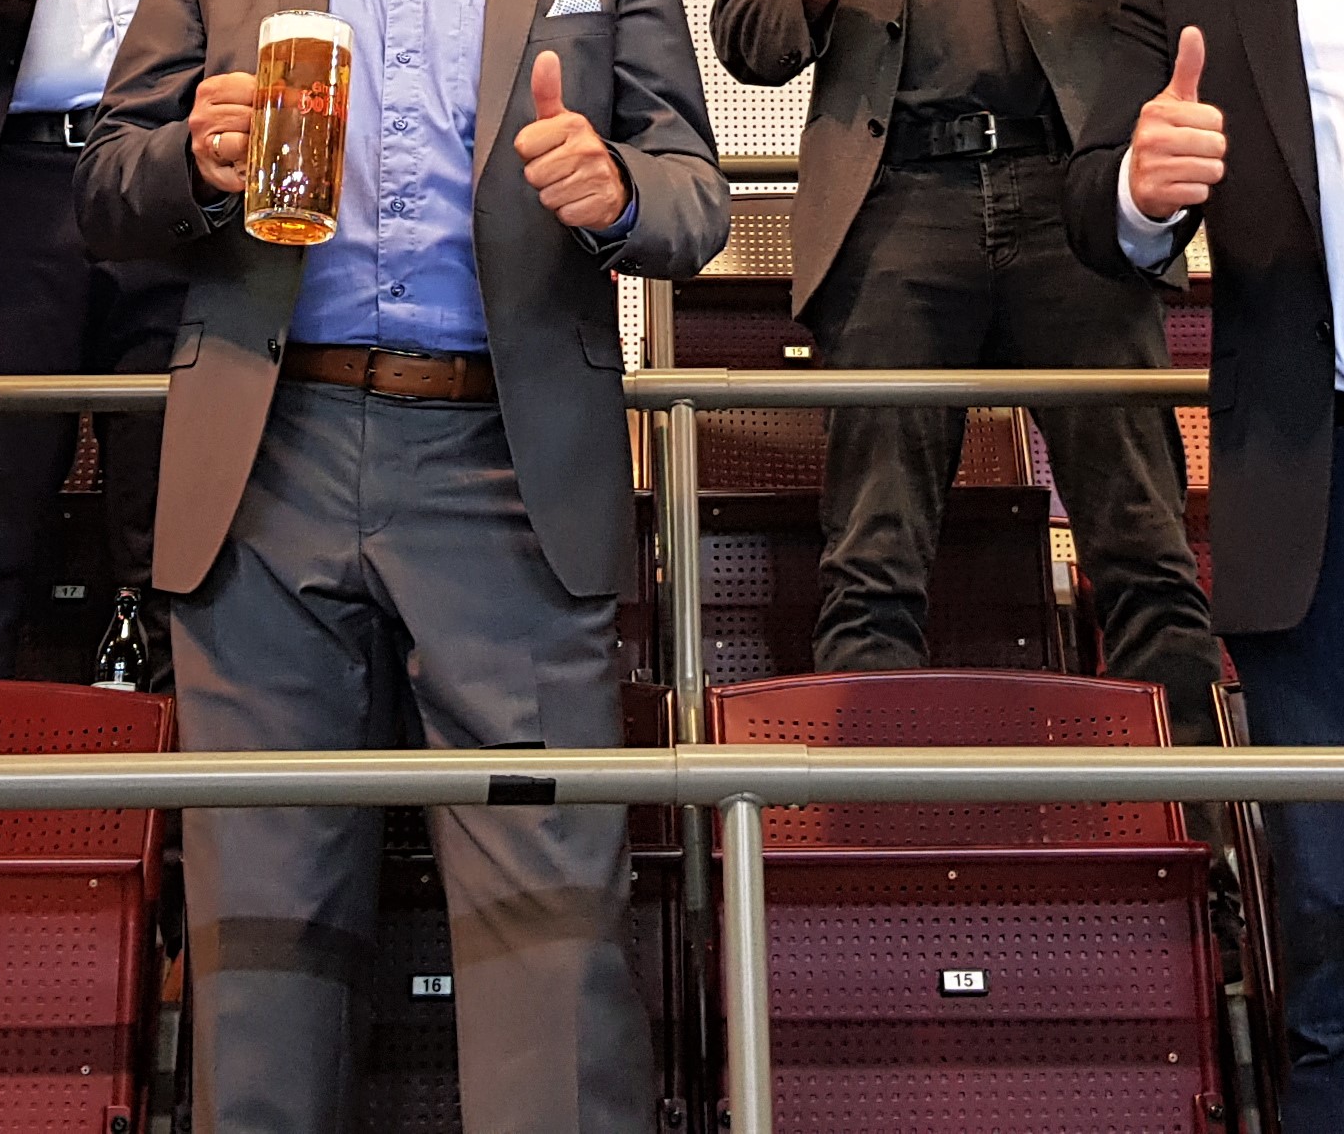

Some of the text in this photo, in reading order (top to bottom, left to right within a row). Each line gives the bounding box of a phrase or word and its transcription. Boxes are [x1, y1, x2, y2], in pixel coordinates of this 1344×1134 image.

[61, 586, 77, 597] 17
[422, 977, 441, 993] 16
[953, 973, 974, 987] 15
